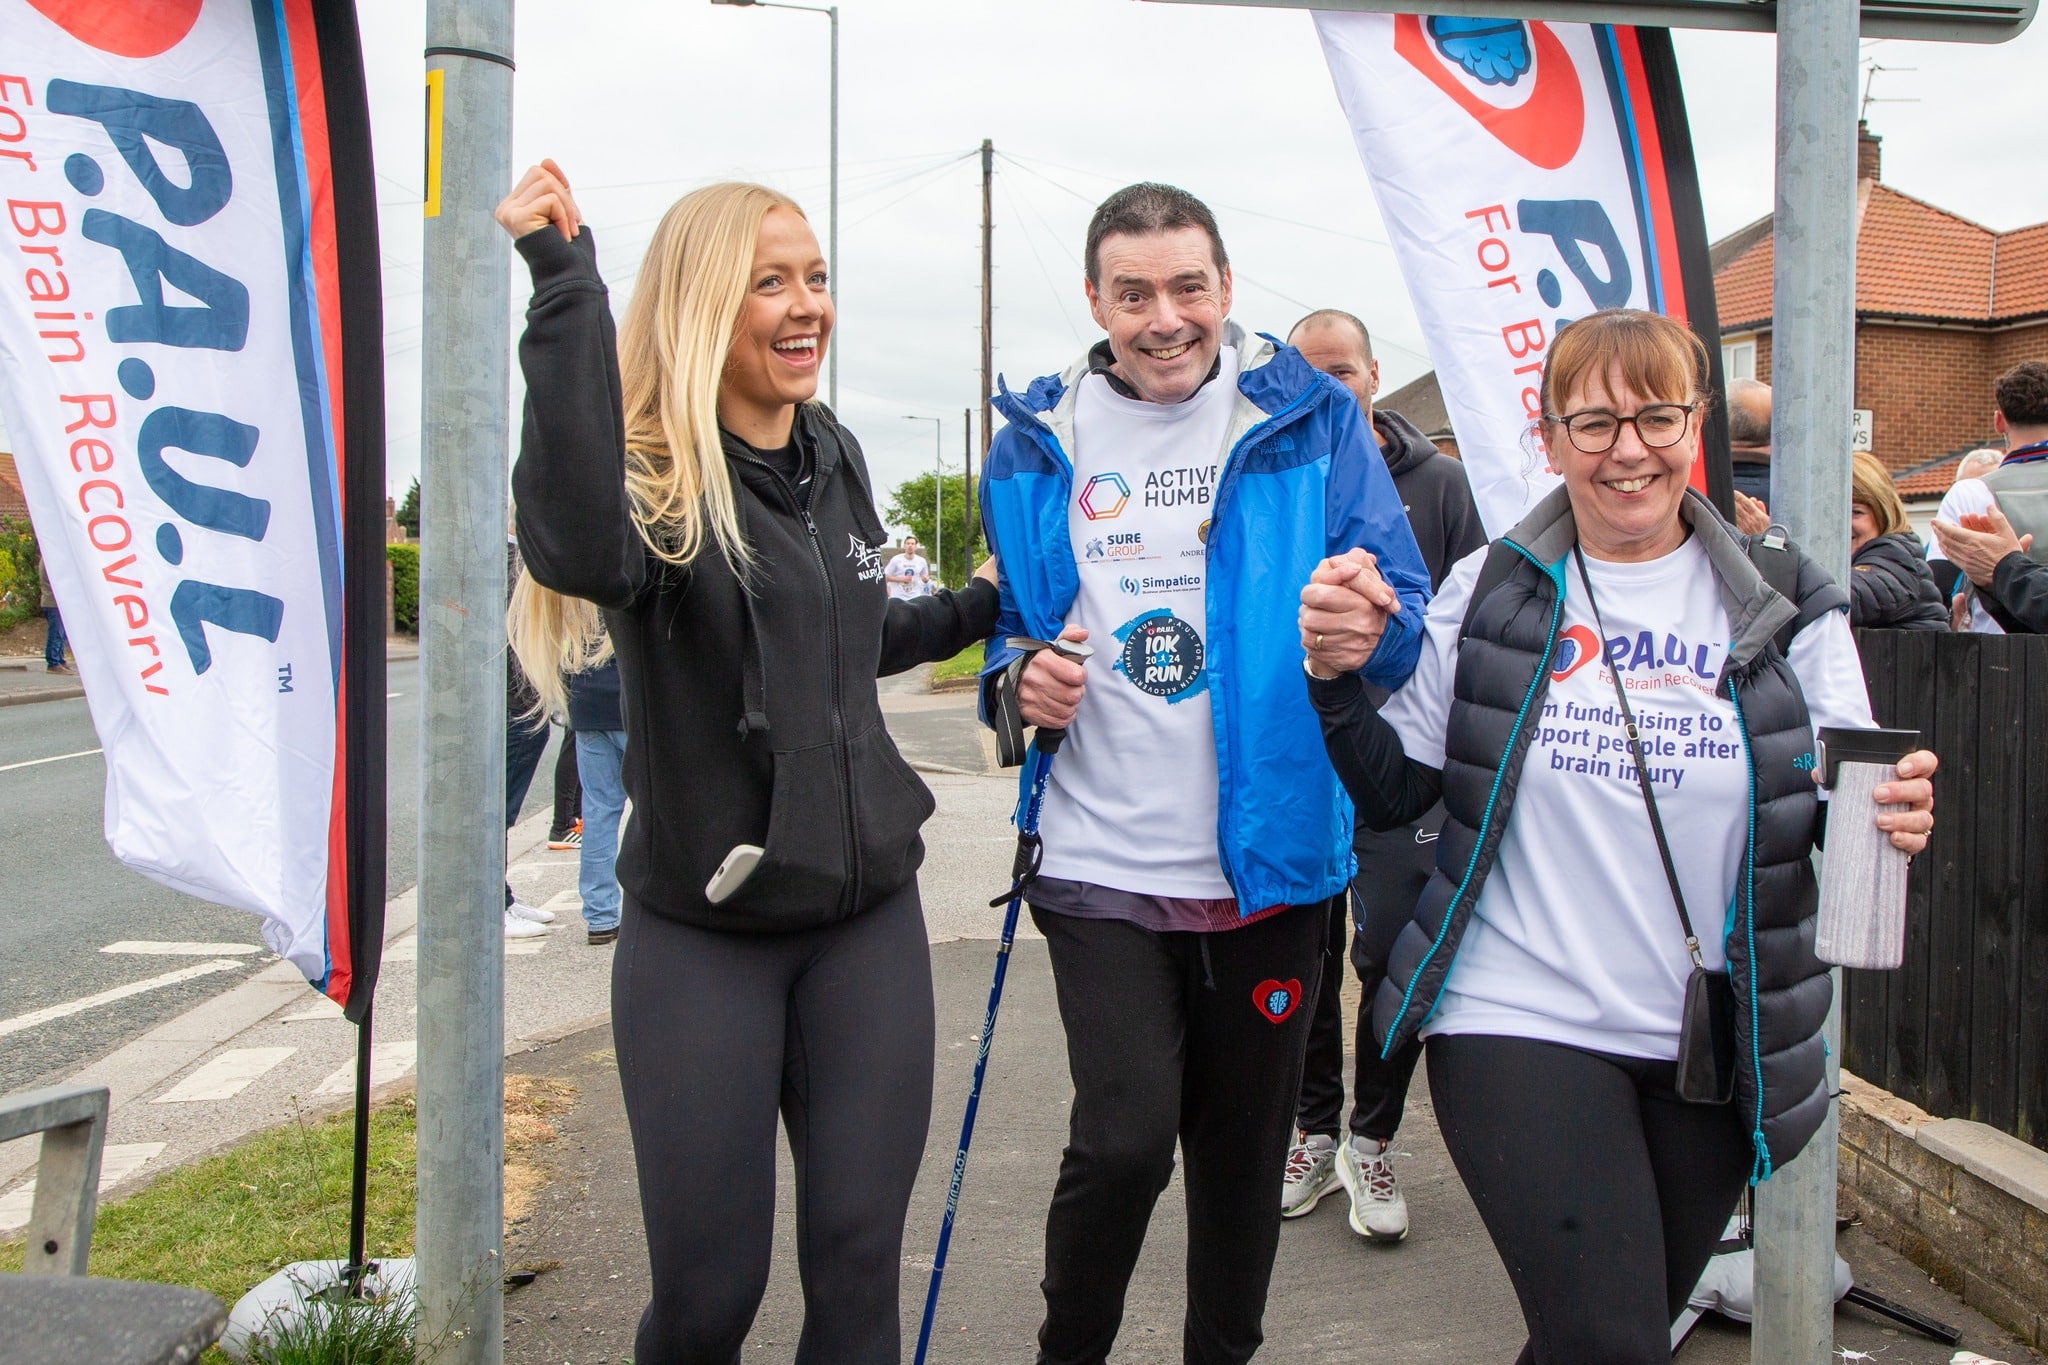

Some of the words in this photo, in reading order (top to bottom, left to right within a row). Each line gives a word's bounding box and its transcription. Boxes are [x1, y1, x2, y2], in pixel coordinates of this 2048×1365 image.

[1465, 204, 1522, 294] For
[7, 198, 94, 362] Brain
[46, 78, 285, 676] P.A.U.L
[1853, 412, 1861, 426] R
[1145, 486, 1210, 507] HUMB
[1107, 533, 1141, 545] SURE
[1107, 544, 1145, 557] GROUP
[1180, 549, 1205, 557] ANDRE
[1142, 574, 1201, 588] Simpatico
[1136, 620, 1153, 634] RUN
[1125, 635, 1137, 674] CHARITY
[1145, 634, 1180, 655] 10K
[1194, 643, 1202, 660] FOR
[1144, 664, 1184, 684] RUN
[1180, 665, 1200, 689] BRAIN
[1133, 677, 1177, 695] RECOVERY
[1625, 676, 1661, 690] Brain
[1664, 673, 1716, 697] Recover
[1543, 704, 1558, 718] m
[1700, 713, 1723, 731] to
[1684, 737, 1740, 759] after
[1551, 749, 1610, 777] brain
[1618, 758, 1684, 789] inury
